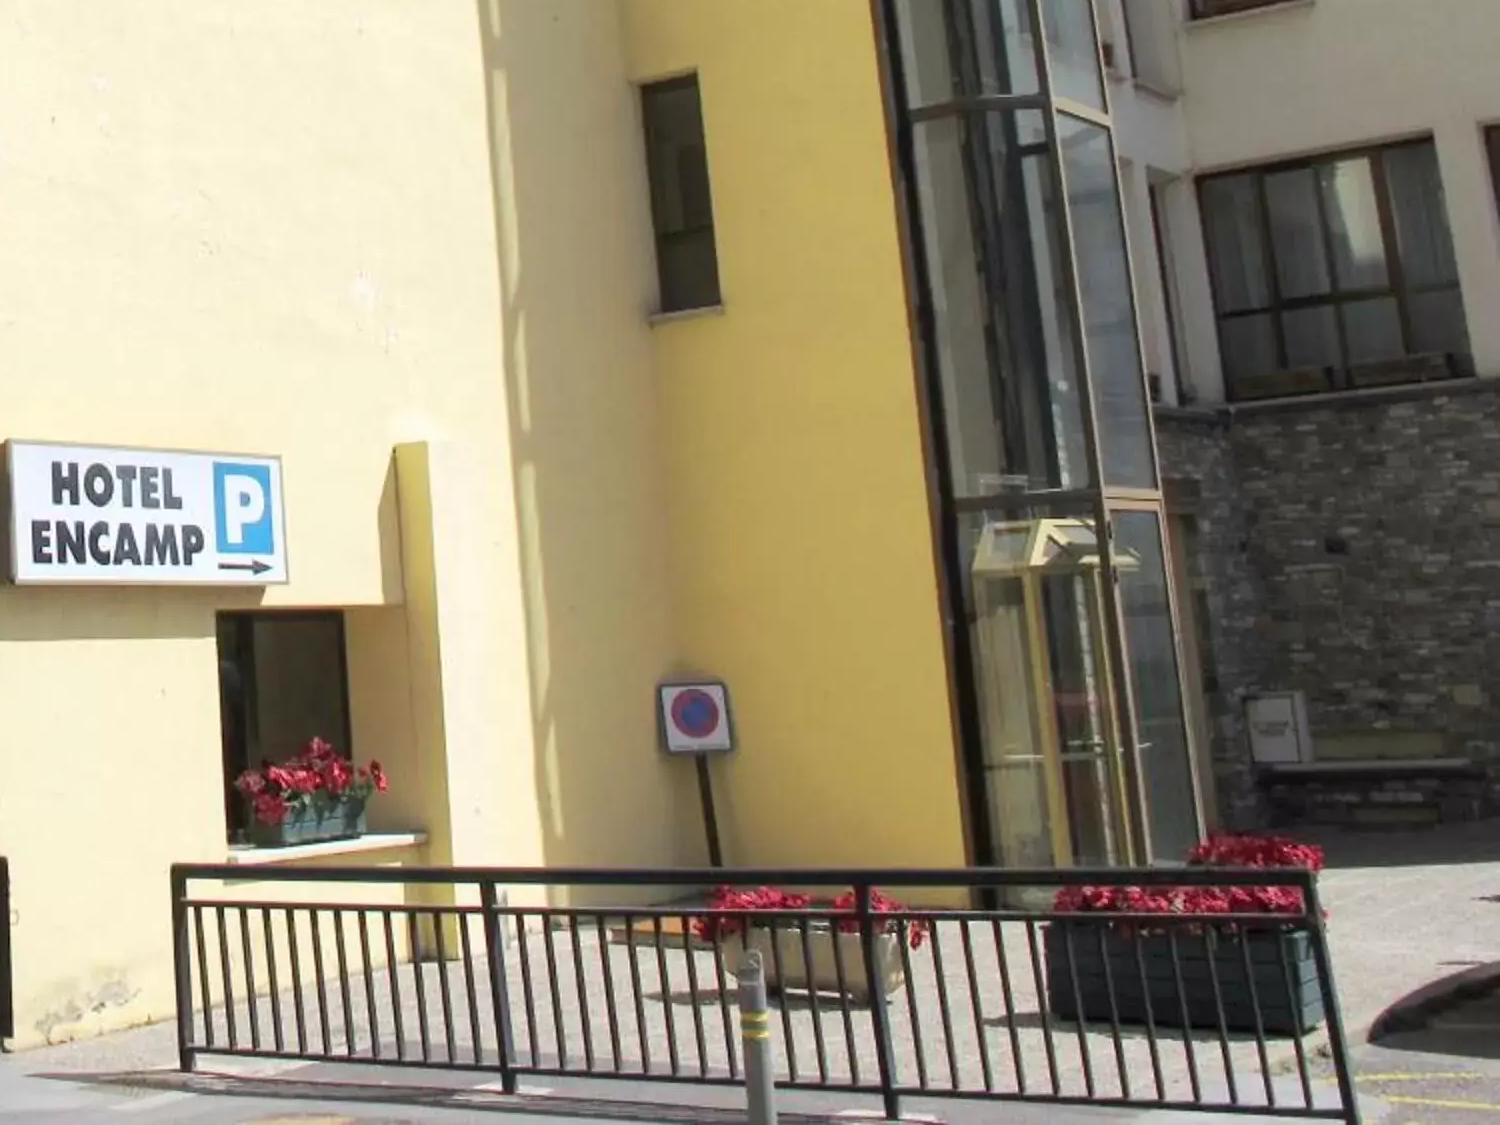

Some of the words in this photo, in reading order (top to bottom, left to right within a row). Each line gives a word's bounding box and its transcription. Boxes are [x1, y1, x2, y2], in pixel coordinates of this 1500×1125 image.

[51, 460, 183, 510] HOTEL
[223, 473, 266, 545] P
[31, 519, 205, 566] ENCAMP
